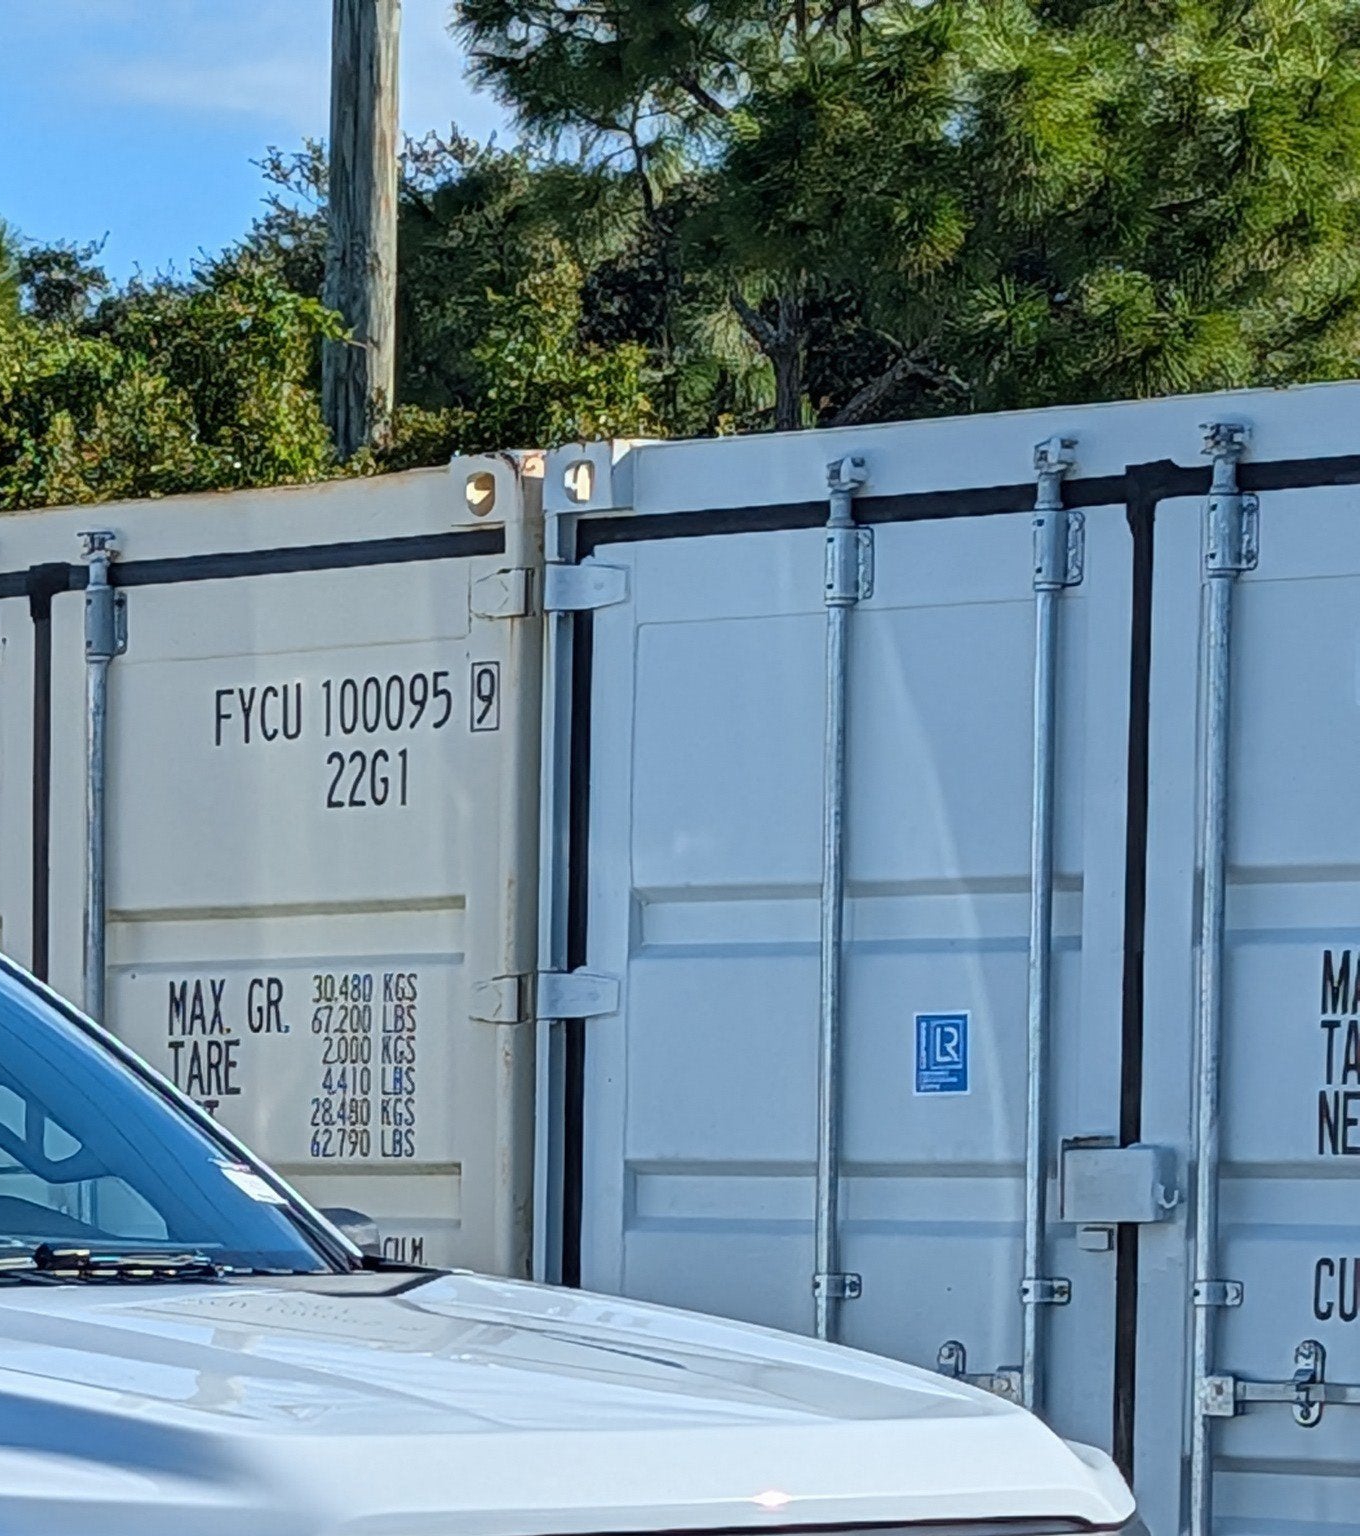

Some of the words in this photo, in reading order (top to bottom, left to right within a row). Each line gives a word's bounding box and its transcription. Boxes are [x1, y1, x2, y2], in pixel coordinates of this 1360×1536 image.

[215, 682, 302, 746] FYCU
[321, 671, 452, 737] 100095
[475, 667, 496, 726] 9
[326, 748, 408, 808] 22G1
[311, 973, 374, 1003] 30.480
[383, 973, 418, 1002] KGS
[168, 978, 231, 1036] MAX.
[247, 977, 290, 1033] GR.
[382, 1003, 417, 1034] LBS
[381, 1035, 416, 1064] KGS
[168, 1039, 241, 1096] TARE
[381, 1066, 416, 1096] LBS
[381, 1097, 416, 1126] KGS
[381, 1128, 416, 1158] LBS
